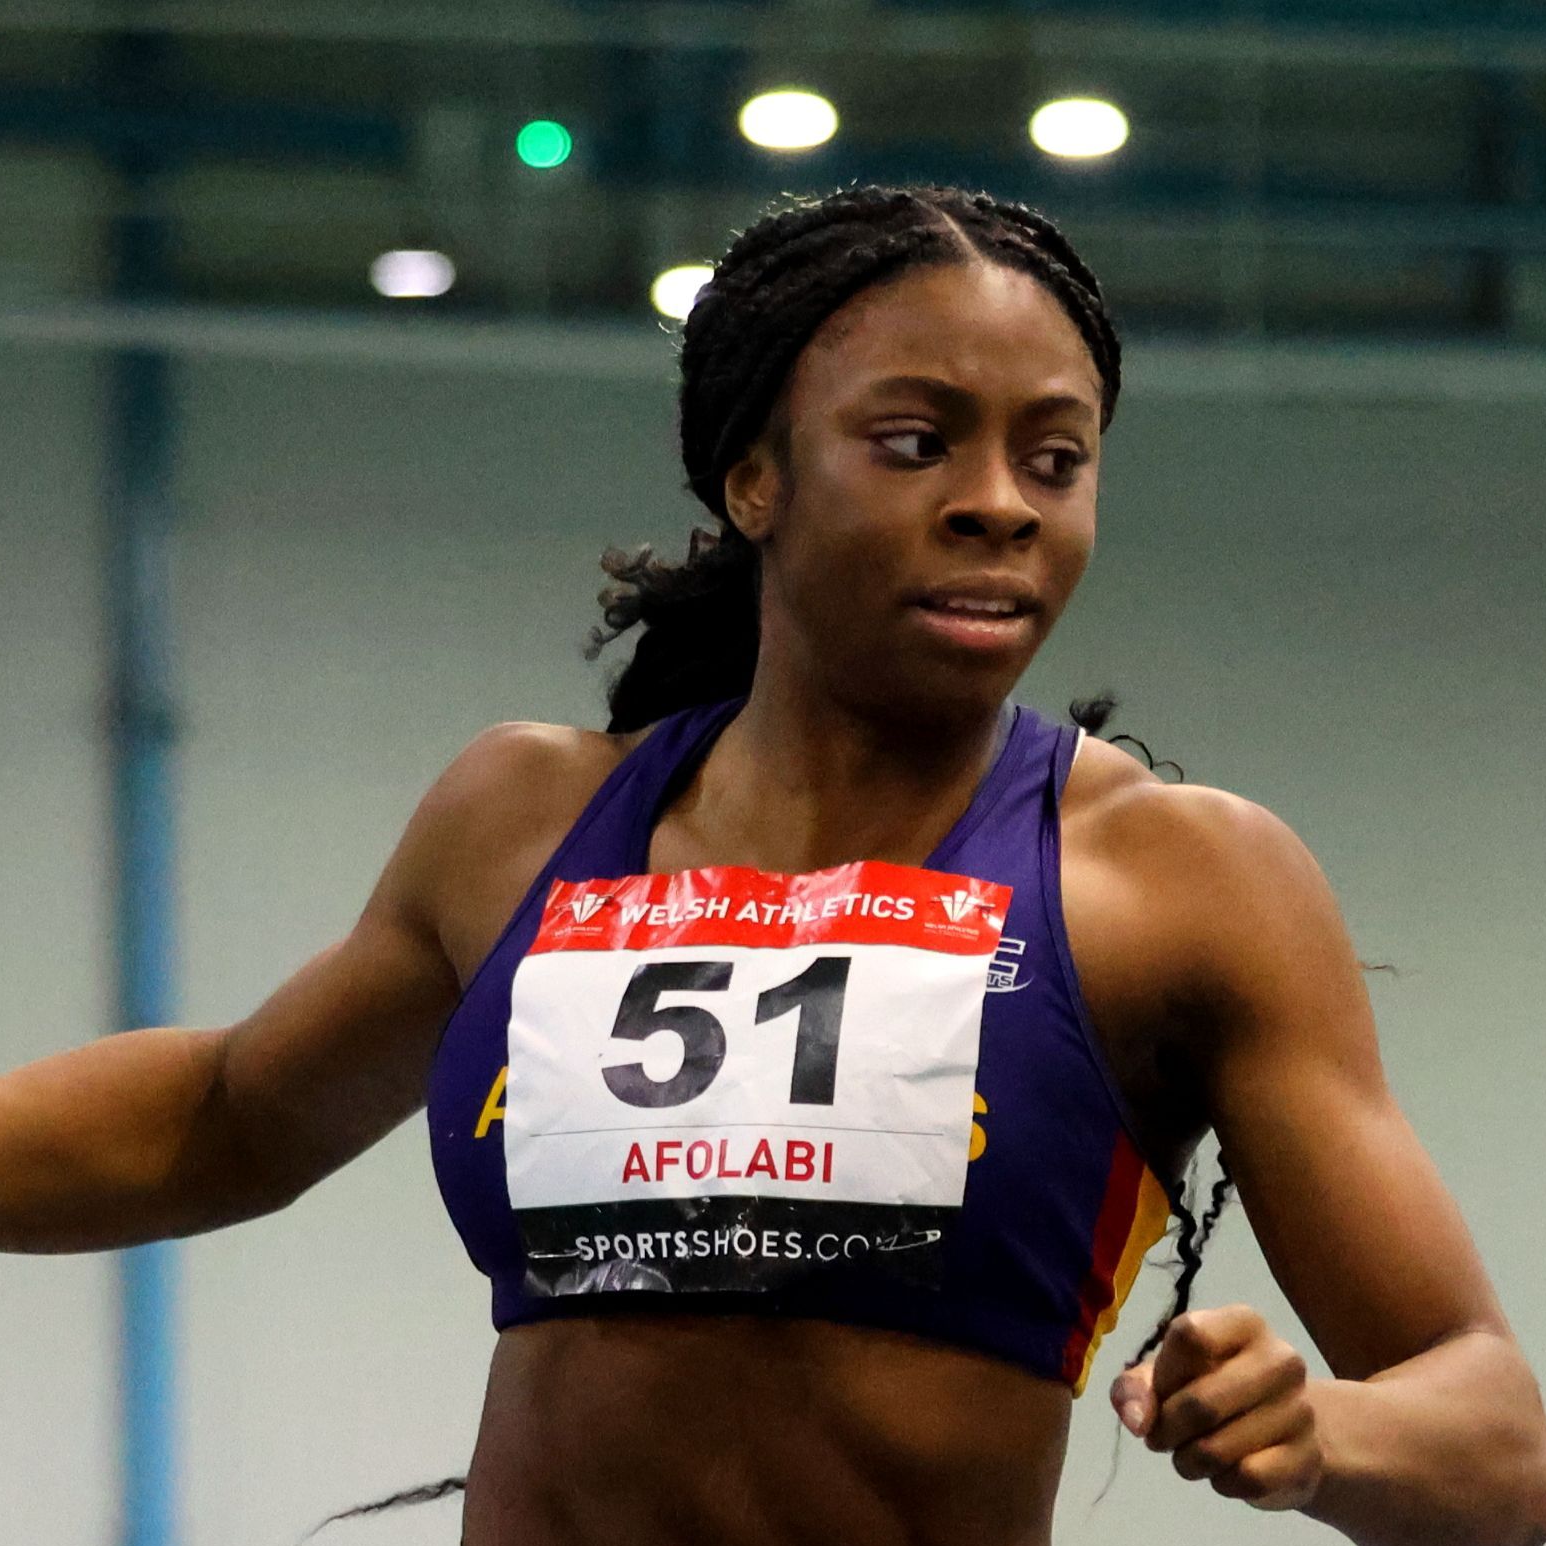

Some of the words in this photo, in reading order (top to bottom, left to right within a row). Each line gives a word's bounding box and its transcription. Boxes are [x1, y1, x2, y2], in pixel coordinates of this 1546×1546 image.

[620, 896, 731, 929] WELSH
[735, 892, 916, 926] ATHLETICS
[600, 955, 853, 1109] 51
[621, 1138, 834, 1184] AFOLABI
